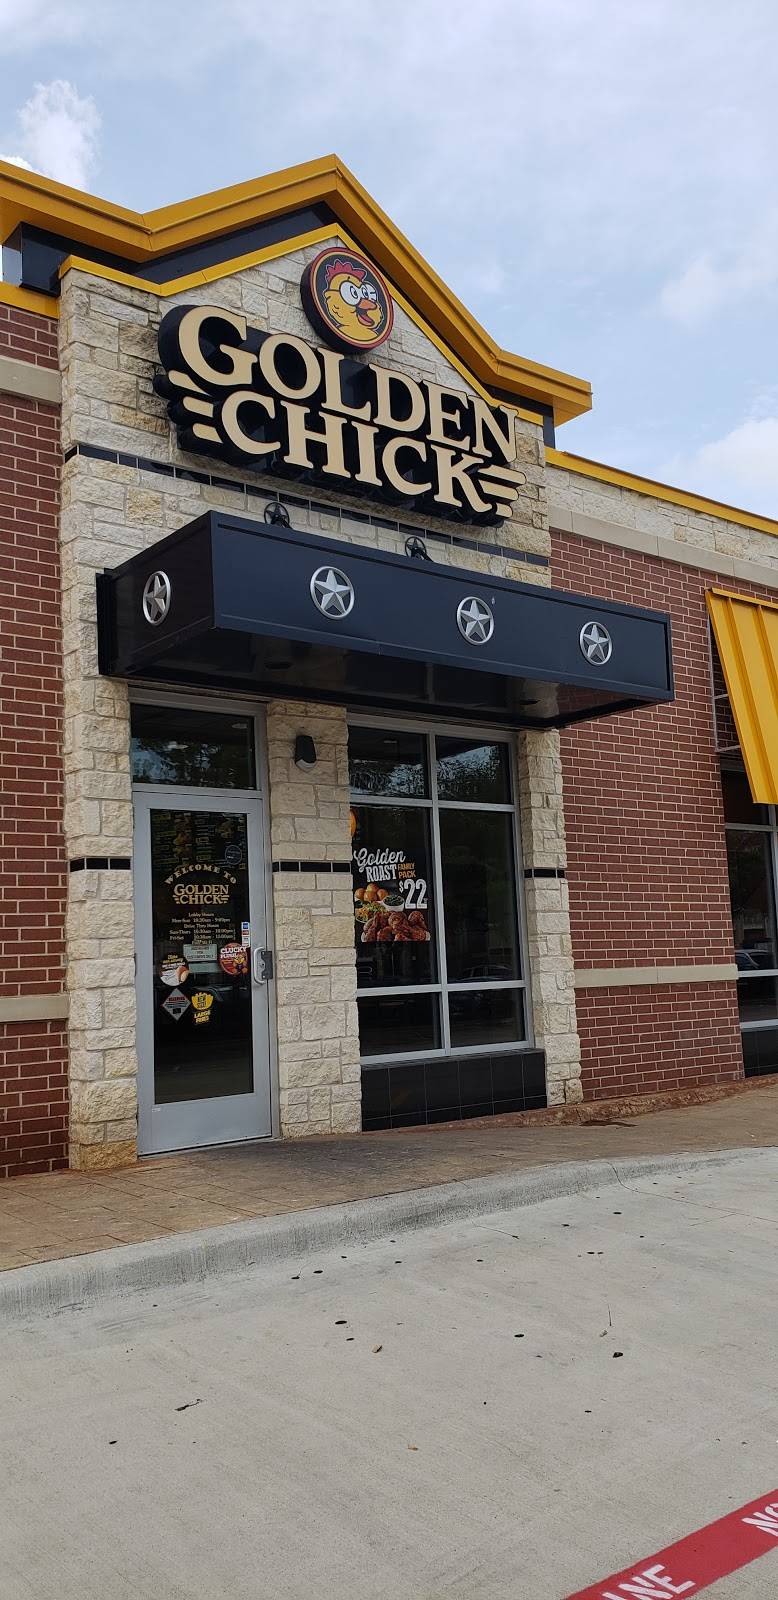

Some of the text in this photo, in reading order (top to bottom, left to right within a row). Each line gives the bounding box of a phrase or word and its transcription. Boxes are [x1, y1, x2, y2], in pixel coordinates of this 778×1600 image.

[178, 304, 519, 463] GOLDEN
[221, 390, 493, 514] CHICK
[353, 848, 406, 873] Golden
[164, 863, 237, 884] WELCOME TO
[366, 862, 415, 882] ROAST FAMILY
[398, 870, 416, 879] PACK
[173, 884, 230, 896] GOLDEN
[179, 895, 223, 905] CHICK
[398, 879, 428, 909] $22
[220, 946, 248, 954] CLUCKY
